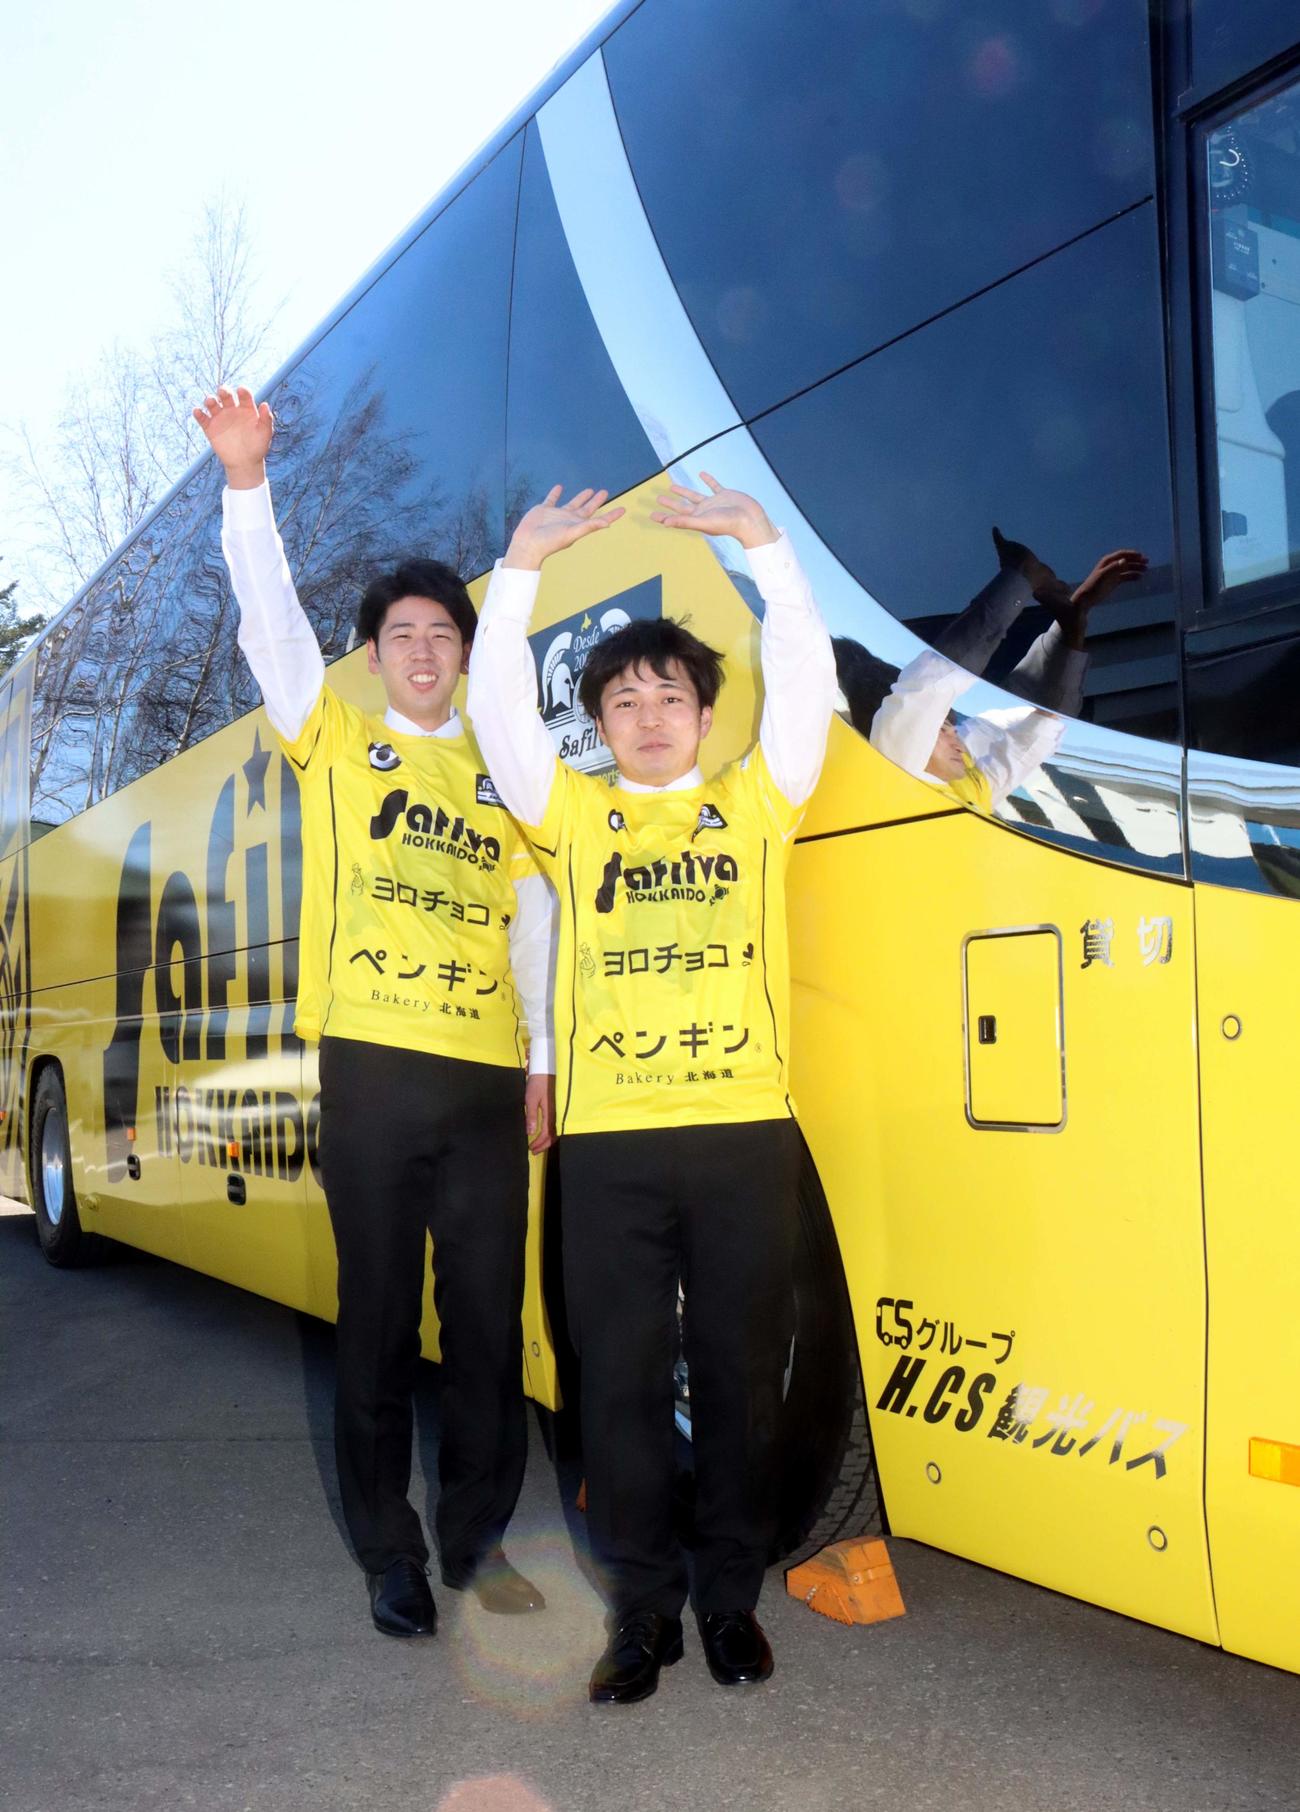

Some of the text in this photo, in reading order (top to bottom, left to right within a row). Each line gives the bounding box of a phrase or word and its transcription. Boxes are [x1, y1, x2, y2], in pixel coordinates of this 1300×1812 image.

[573, 625, 600, 653] Desde
[401, 833, 478, 865] HOKKAIDO
[371, 876, 490, 927] ヨロチョコ
[626, 887, 706, 904] HOKKAIDO
[349, 948, 498, 996] ペンギン
[603, 942, 729, 977] ヨロチョコ
[371, 989, 481, 1020] Bakery 北海道
[590, 1021, 749, 1059] ペンギン
[615, 1068, 734, 1085] Bakery 北海道
